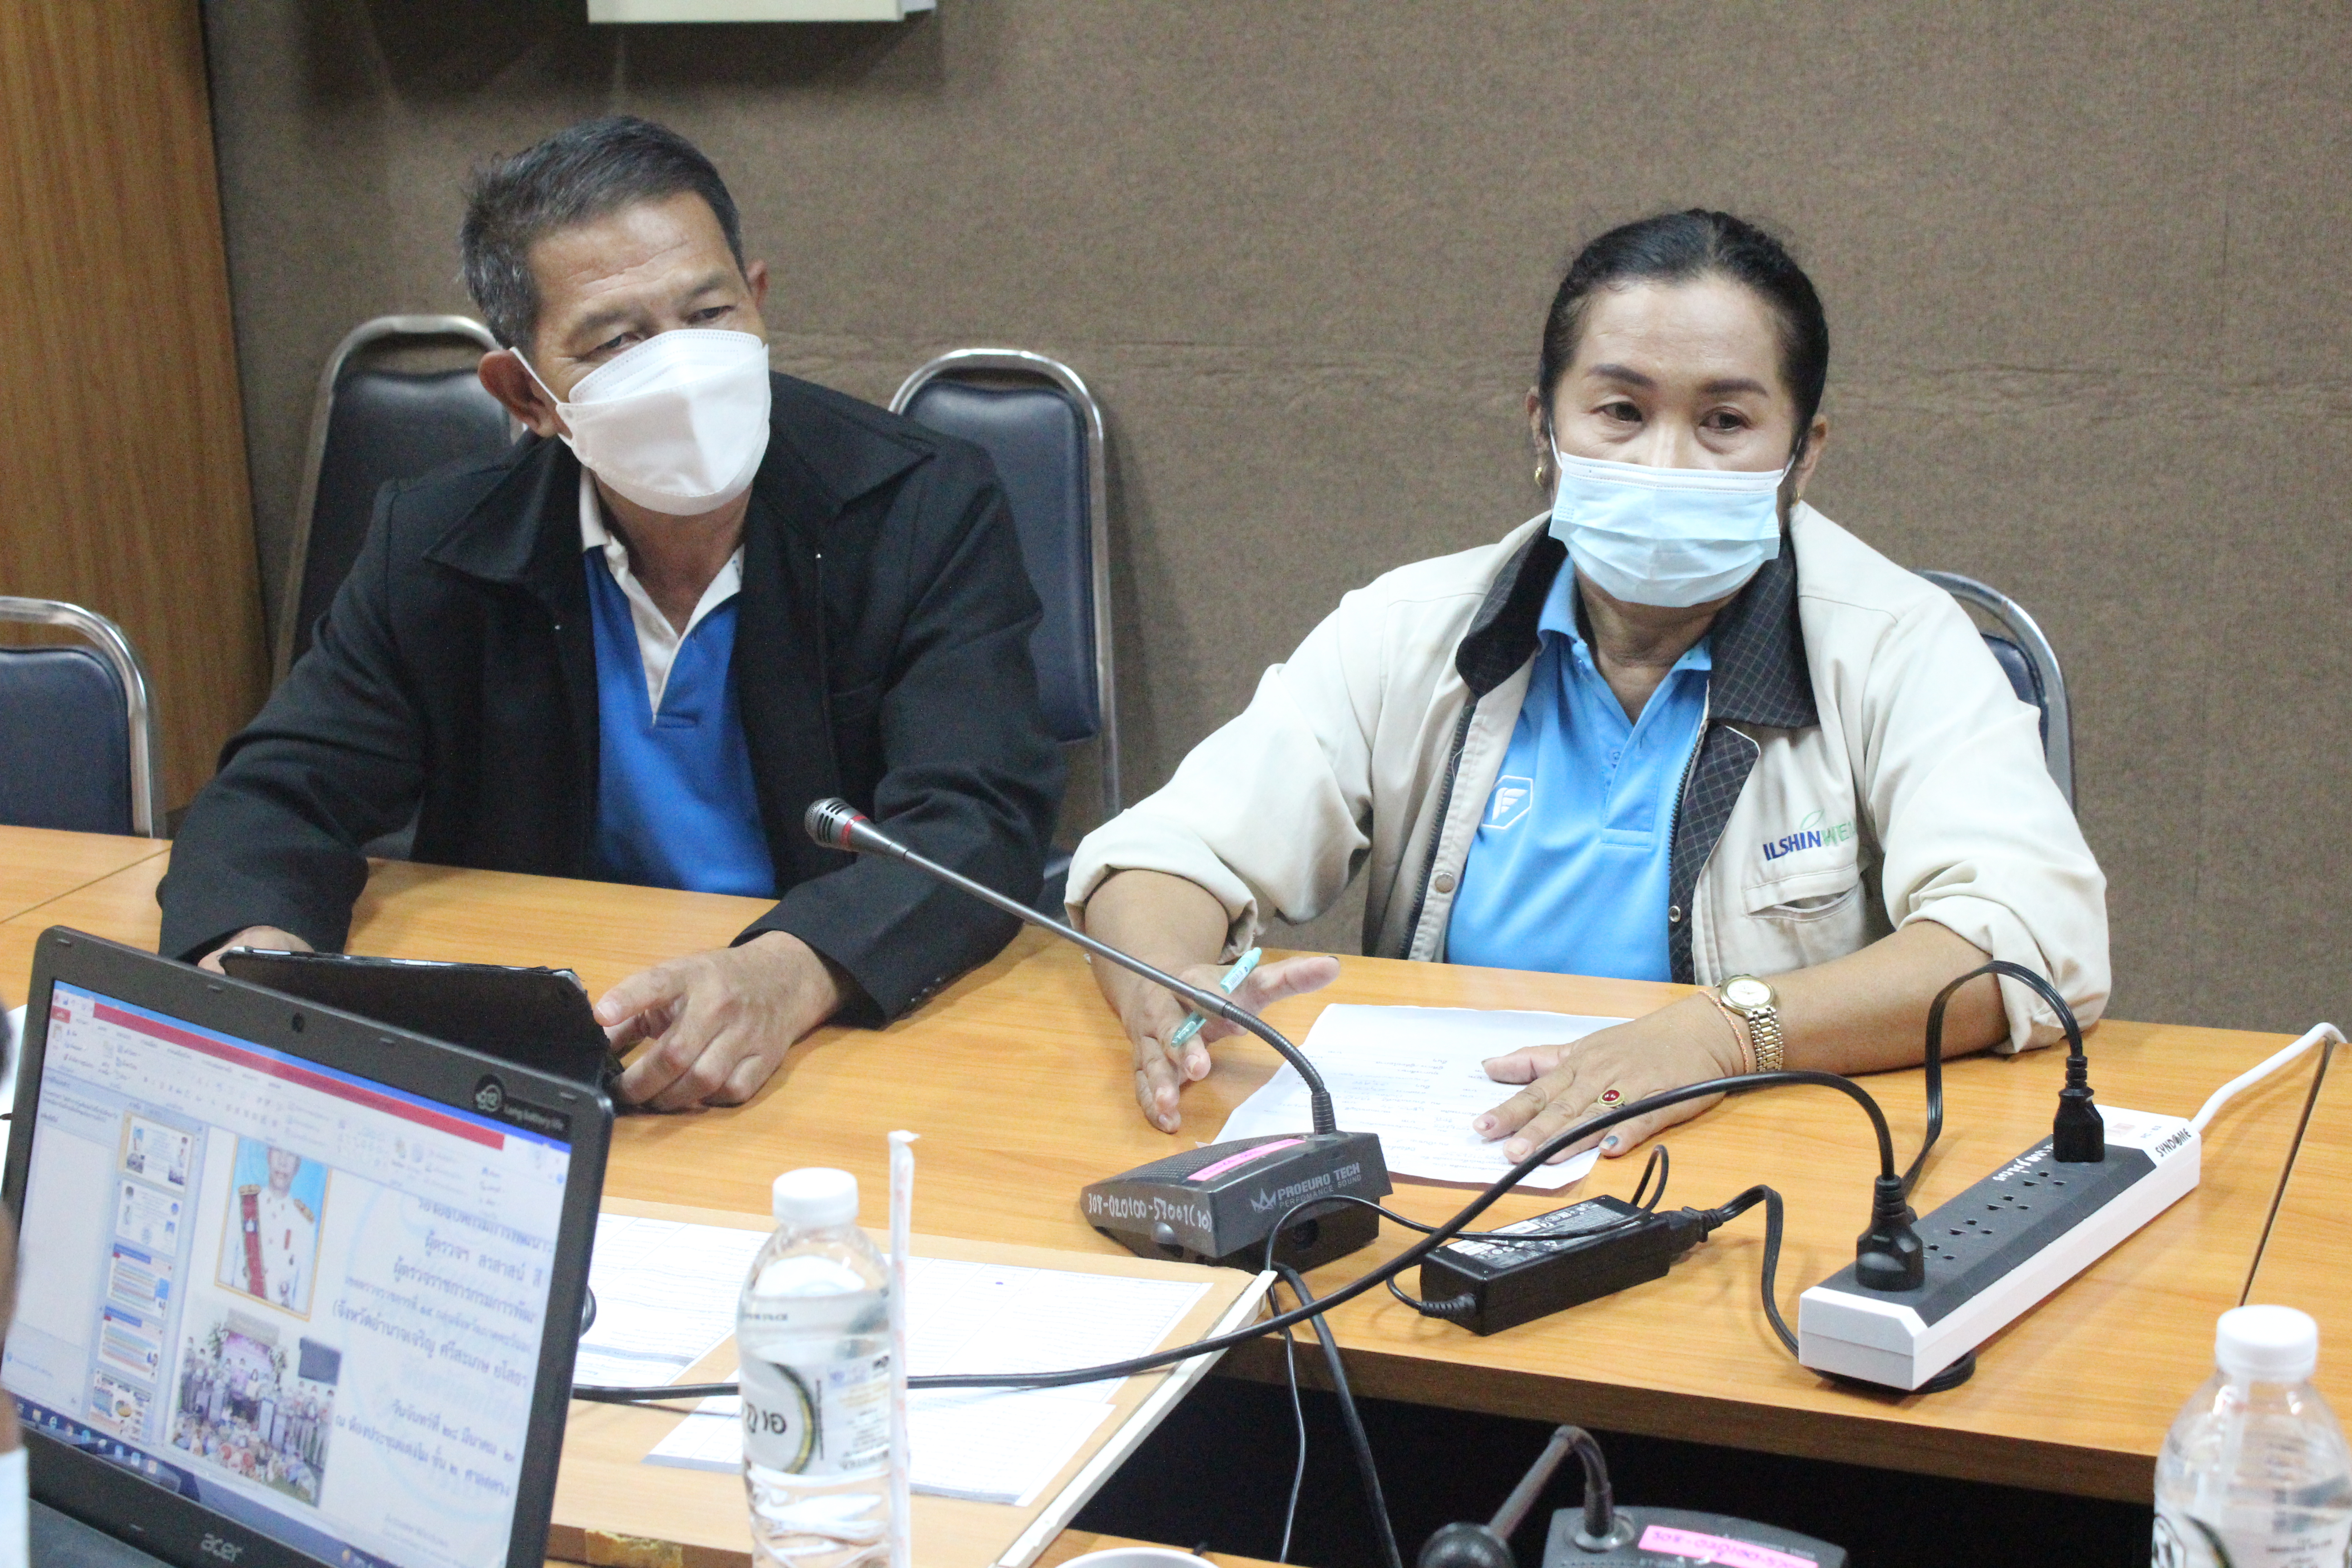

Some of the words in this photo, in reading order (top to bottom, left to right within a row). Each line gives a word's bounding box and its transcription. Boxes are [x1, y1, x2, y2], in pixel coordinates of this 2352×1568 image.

[1277, 1173, 1331, 1200] PROEURO
[1333, 1162, 1361, 1181] TECH
[1279, 1185, 1334, 1209] PERFOMANCE
[1338, 1174, 1362, 1188] SOUND
[201, 1532, 243, 1563] acer
